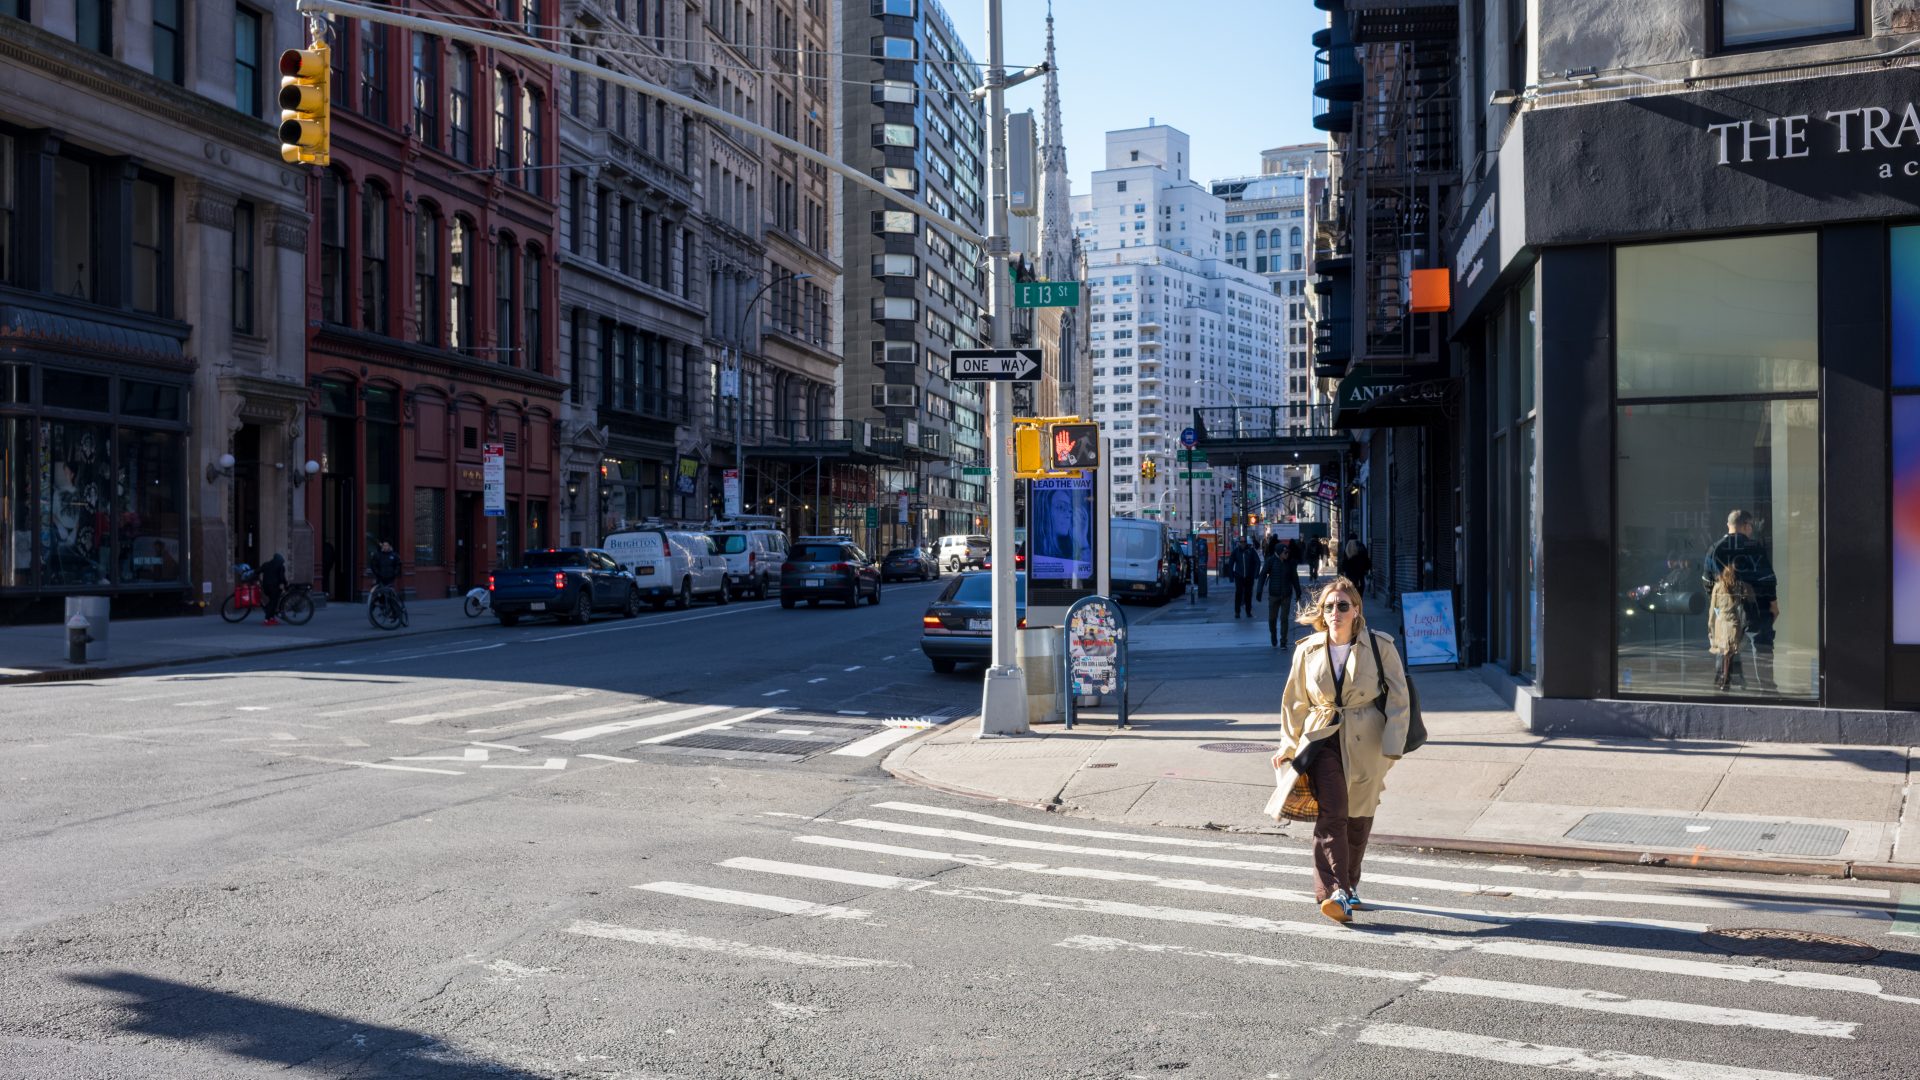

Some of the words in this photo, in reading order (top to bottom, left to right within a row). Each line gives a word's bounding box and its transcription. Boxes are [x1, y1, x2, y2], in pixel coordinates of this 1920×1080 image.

[1707, 114, 1810, 165] THE
[1023, 286, 1031, 304] E
[1037, 285, 1052, 304] 13
[1058, 285, 1068, 297] St
[963, 359, 989, 372] ONE
[1001, 359, 1028, 372] WAY
[1033, 480, 1055, 488] LEAD
[1056, 480, 1072, 488] THE
[1072, 480, 1091, 488] WAY
[1670, 512, 1711, 528] THE
[610, 539, 657, 549] BRIGHTON
[1414, 613, 1442, 626] Legal
[1405, 626, 1453, 638] Cannabis
